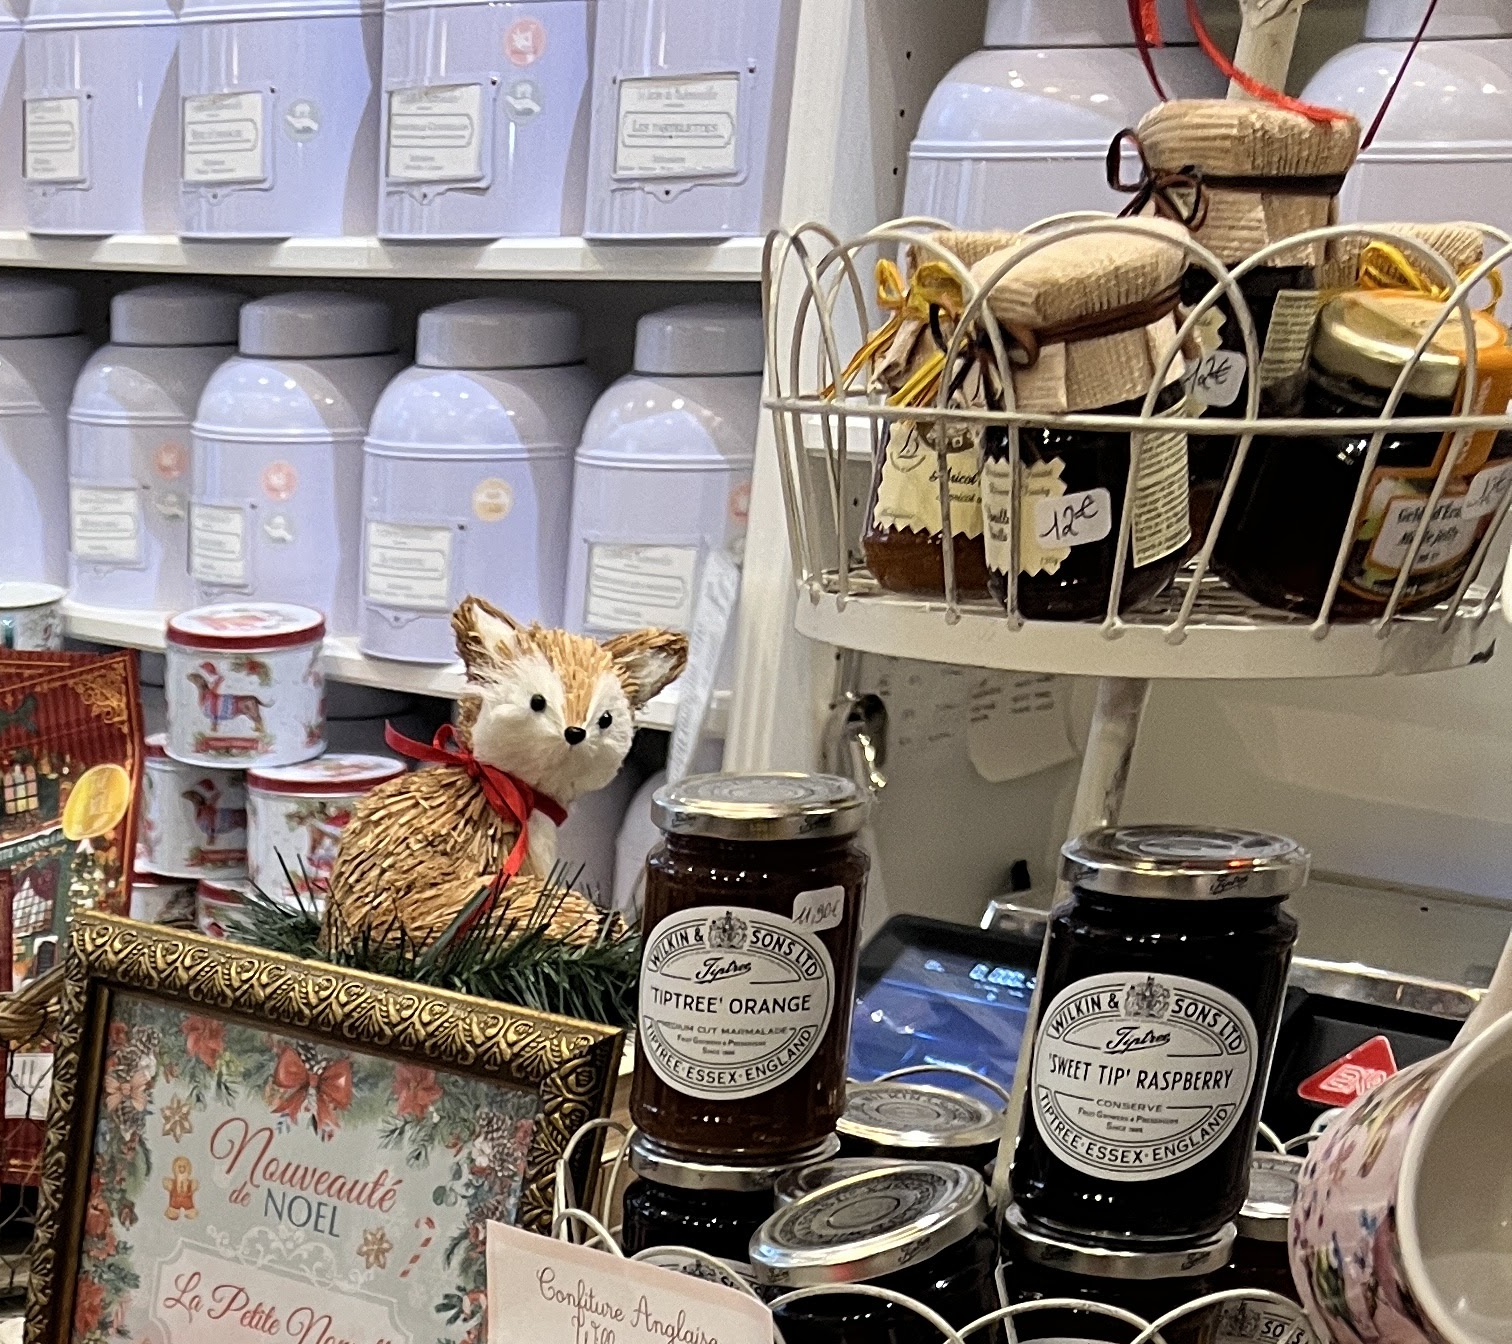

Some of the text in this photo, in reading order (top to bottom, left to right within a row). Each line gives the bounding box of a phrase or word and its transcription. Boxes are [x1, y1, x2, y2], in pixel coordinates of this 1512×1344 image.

[1039, 495, 1099, 540] 12€
[649, 926, 819, 978] WILKIN & SONS LTD
[729, 995, 811, 1015] ORANGE
[1051, 993, 1244, 1052] WILKIN & SONS LTD
[645, 1022, 813, 1081] TIPTREE ENGLAND
[1103, 1026, 1171, 1055] Tiptree
[1096, 1098, 1163, 1113] CONSERVE
[1099, 1064, 1131, 1086] TIP'
[1136, 1068, 1234, 1091] RASPBERRY
[1039, 1093, 1079, 1150] TIPTREE
[1088, 1142, 1143, 1164] ESSEX
[1152, 1107, 1228, 1162] ENGLAND
[210, 1117, 403, 1215] Nouveauté
[229, 1183, 340, 1239] de NOEL
[164, 1271, 204, 1313] La
[207, 1284, 280, 1338] Petite
[536, 1266, 625, 1322] Confiture
